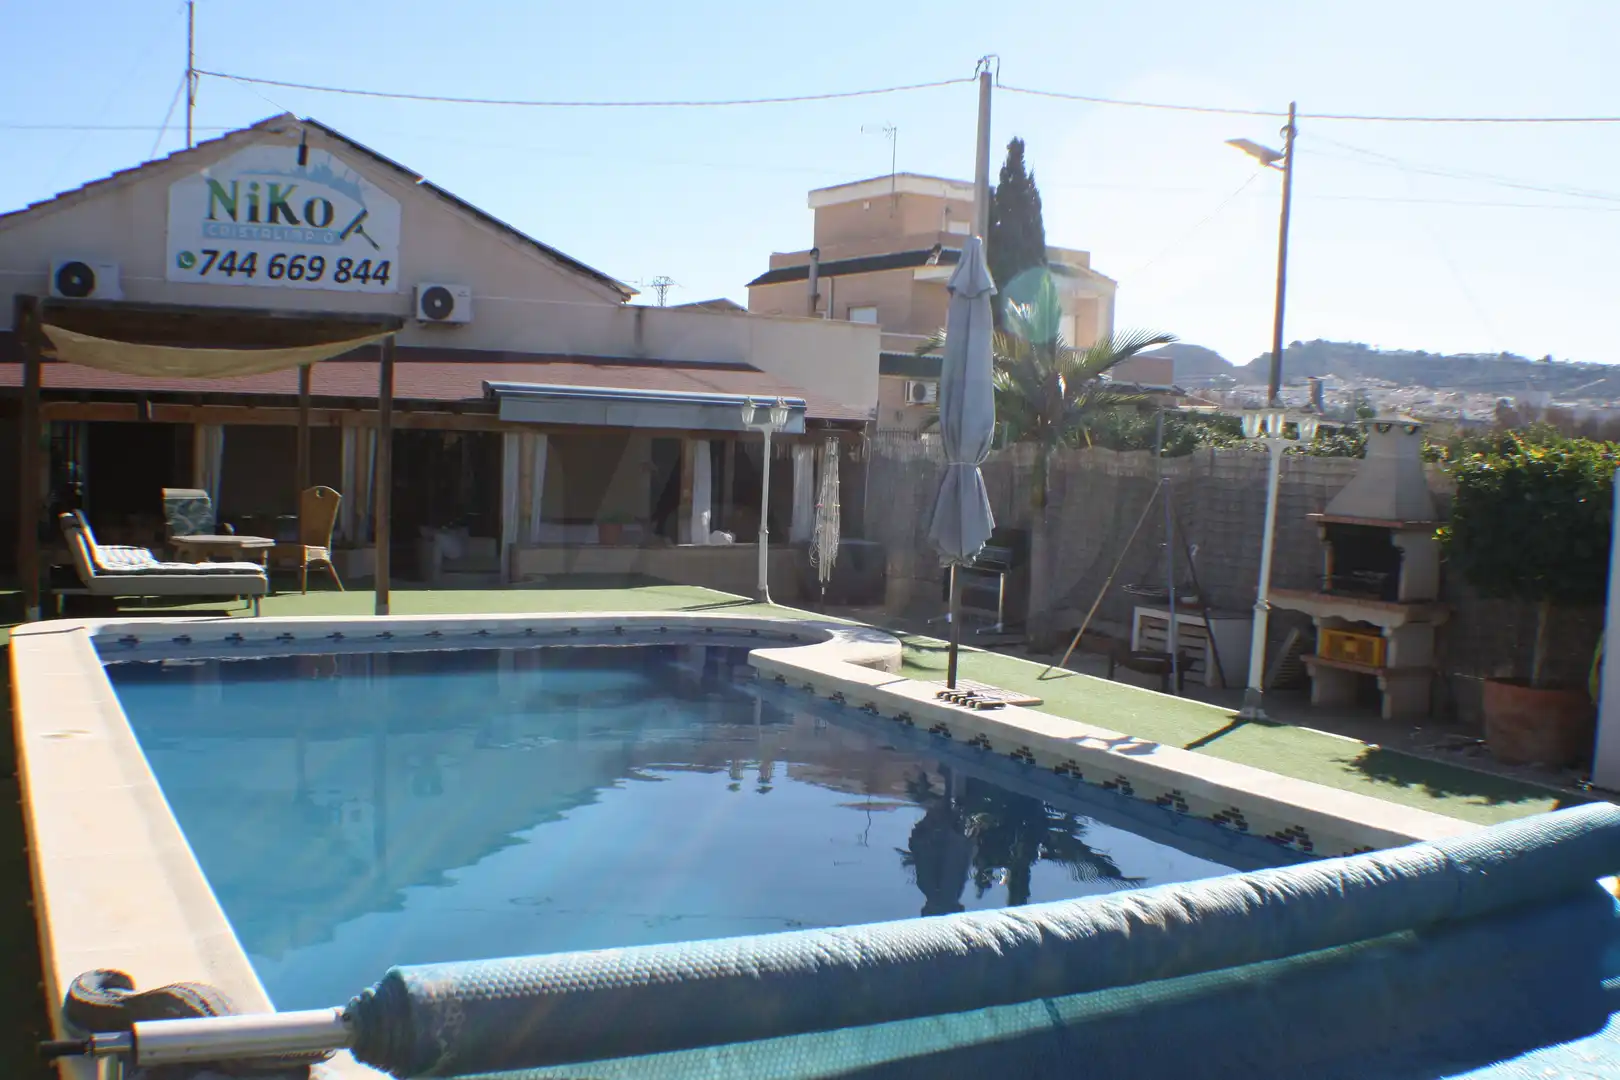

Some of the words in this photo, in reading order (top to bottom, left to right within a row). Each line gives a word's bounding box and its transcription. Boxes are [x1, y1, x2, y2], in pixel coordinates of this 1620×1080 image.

[206, 223, 334, 244] CRISTALIMPO
[199, 249, 258, 278] 744
[268, 253, 326, 282] 669
[334, 257, 391, 285] 844
